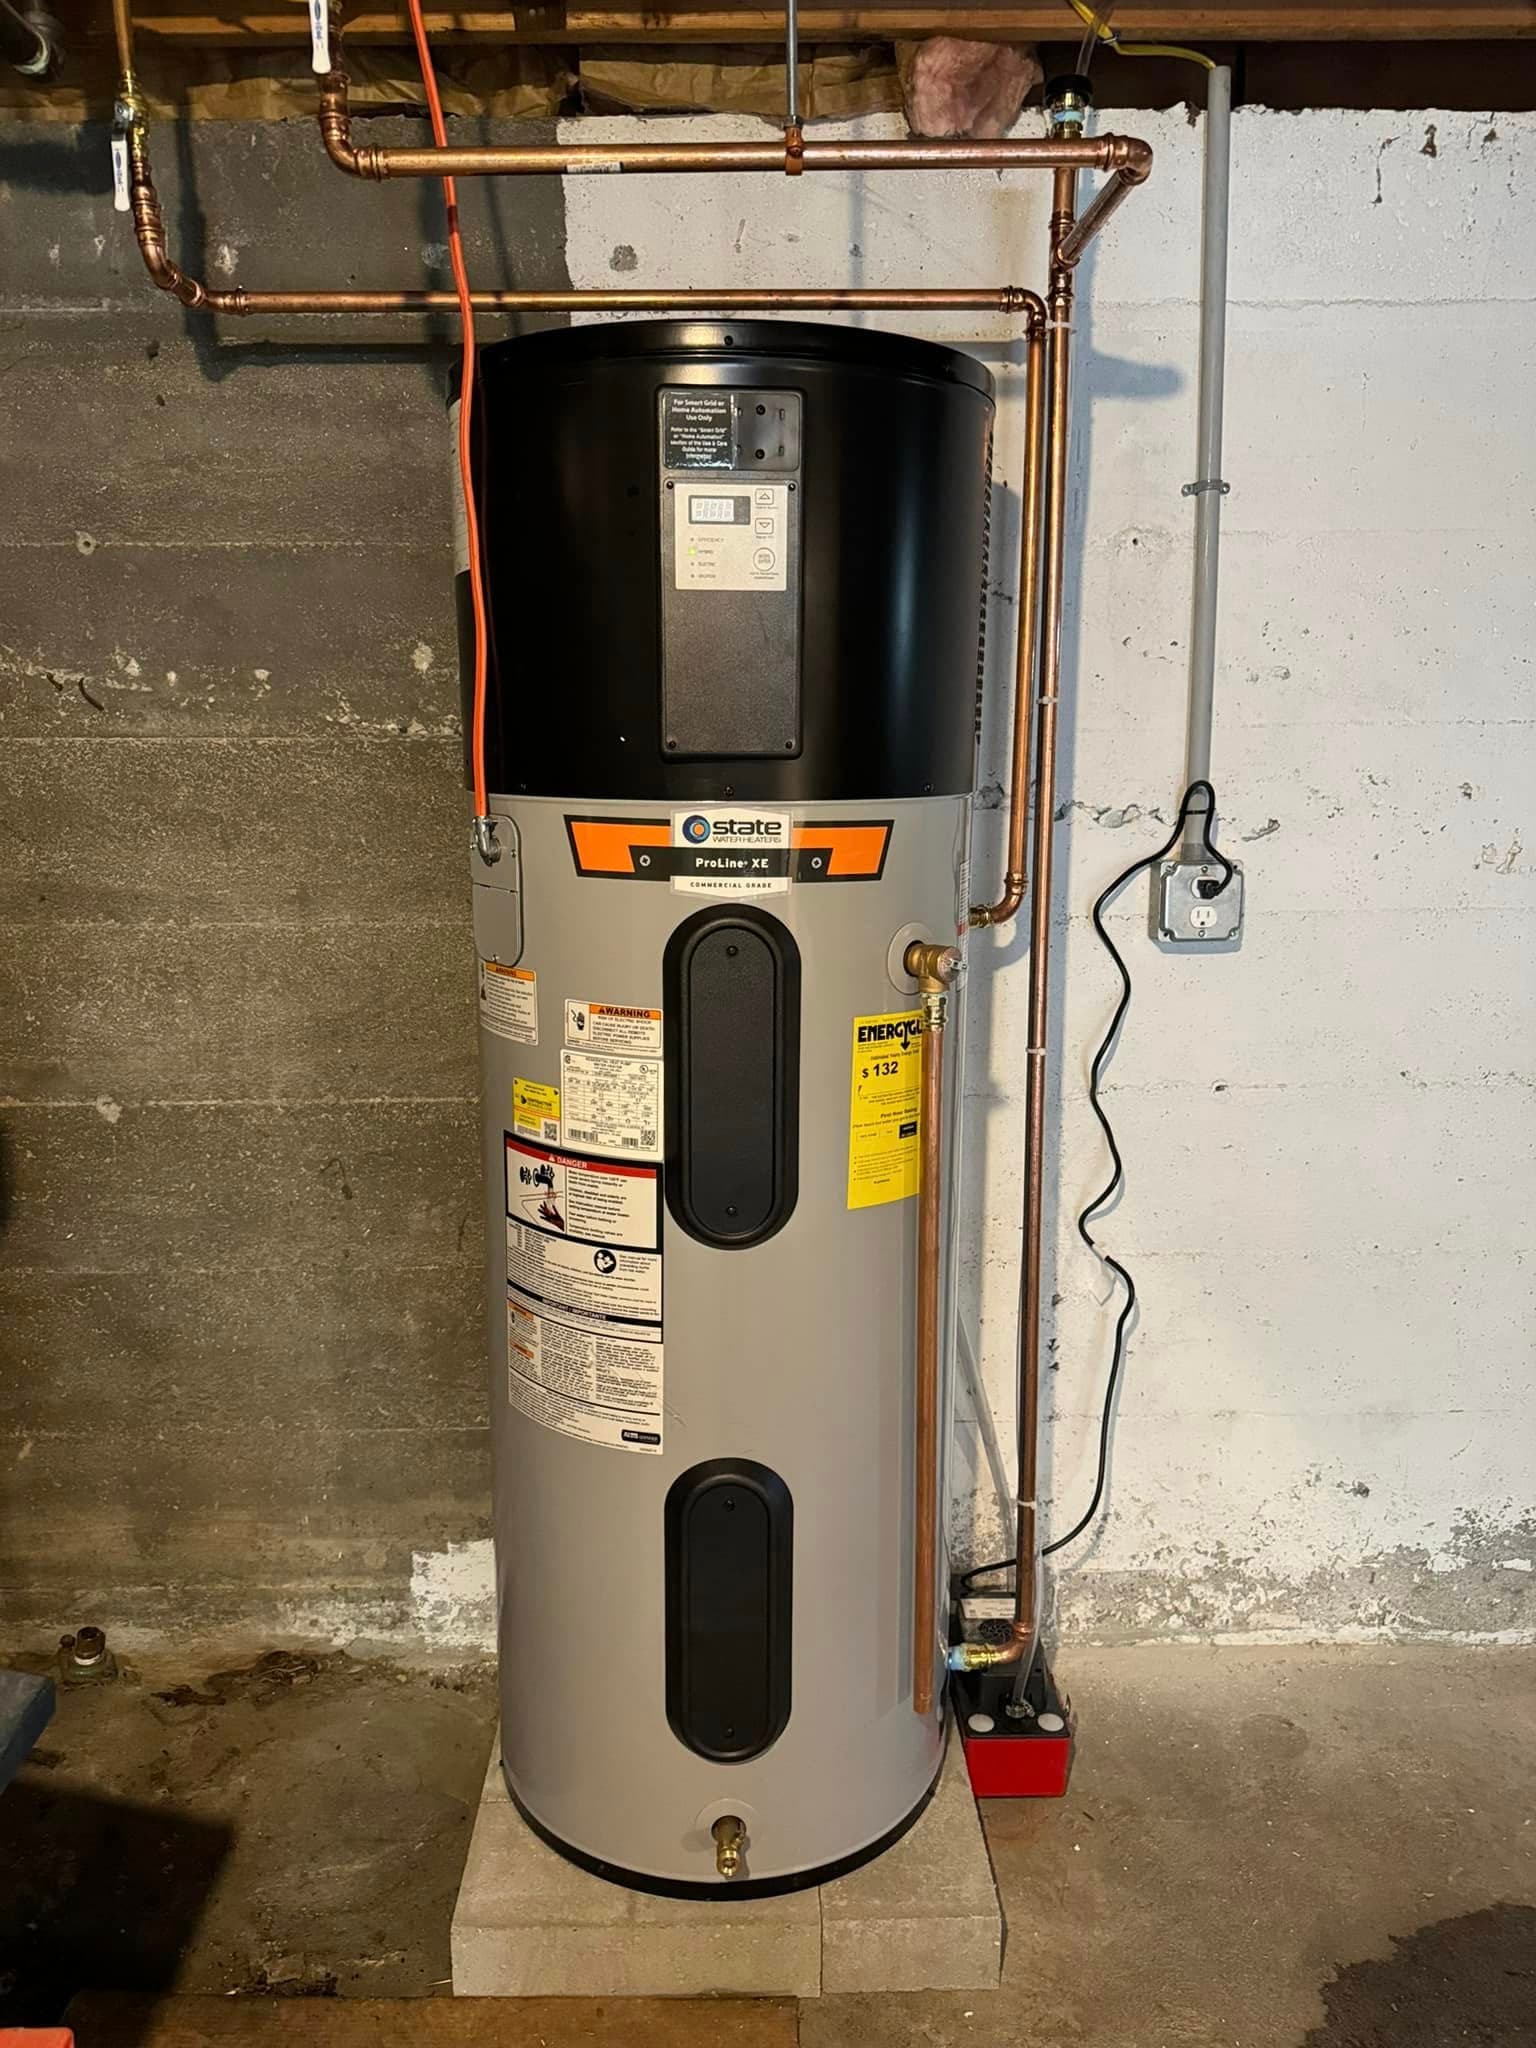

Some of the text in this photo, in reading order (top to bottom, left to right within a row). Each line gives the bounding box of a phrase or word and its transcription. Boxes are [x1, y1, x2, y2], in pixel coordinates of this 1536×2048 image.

[712, 819, 782, 836] state
[751, 858, 769, 869] XE
[604, 1007, 651, 1019] WARNING
[862, 1061, 898, 1079] $ 132
[556, 1155, 588, 1169] DANGER
